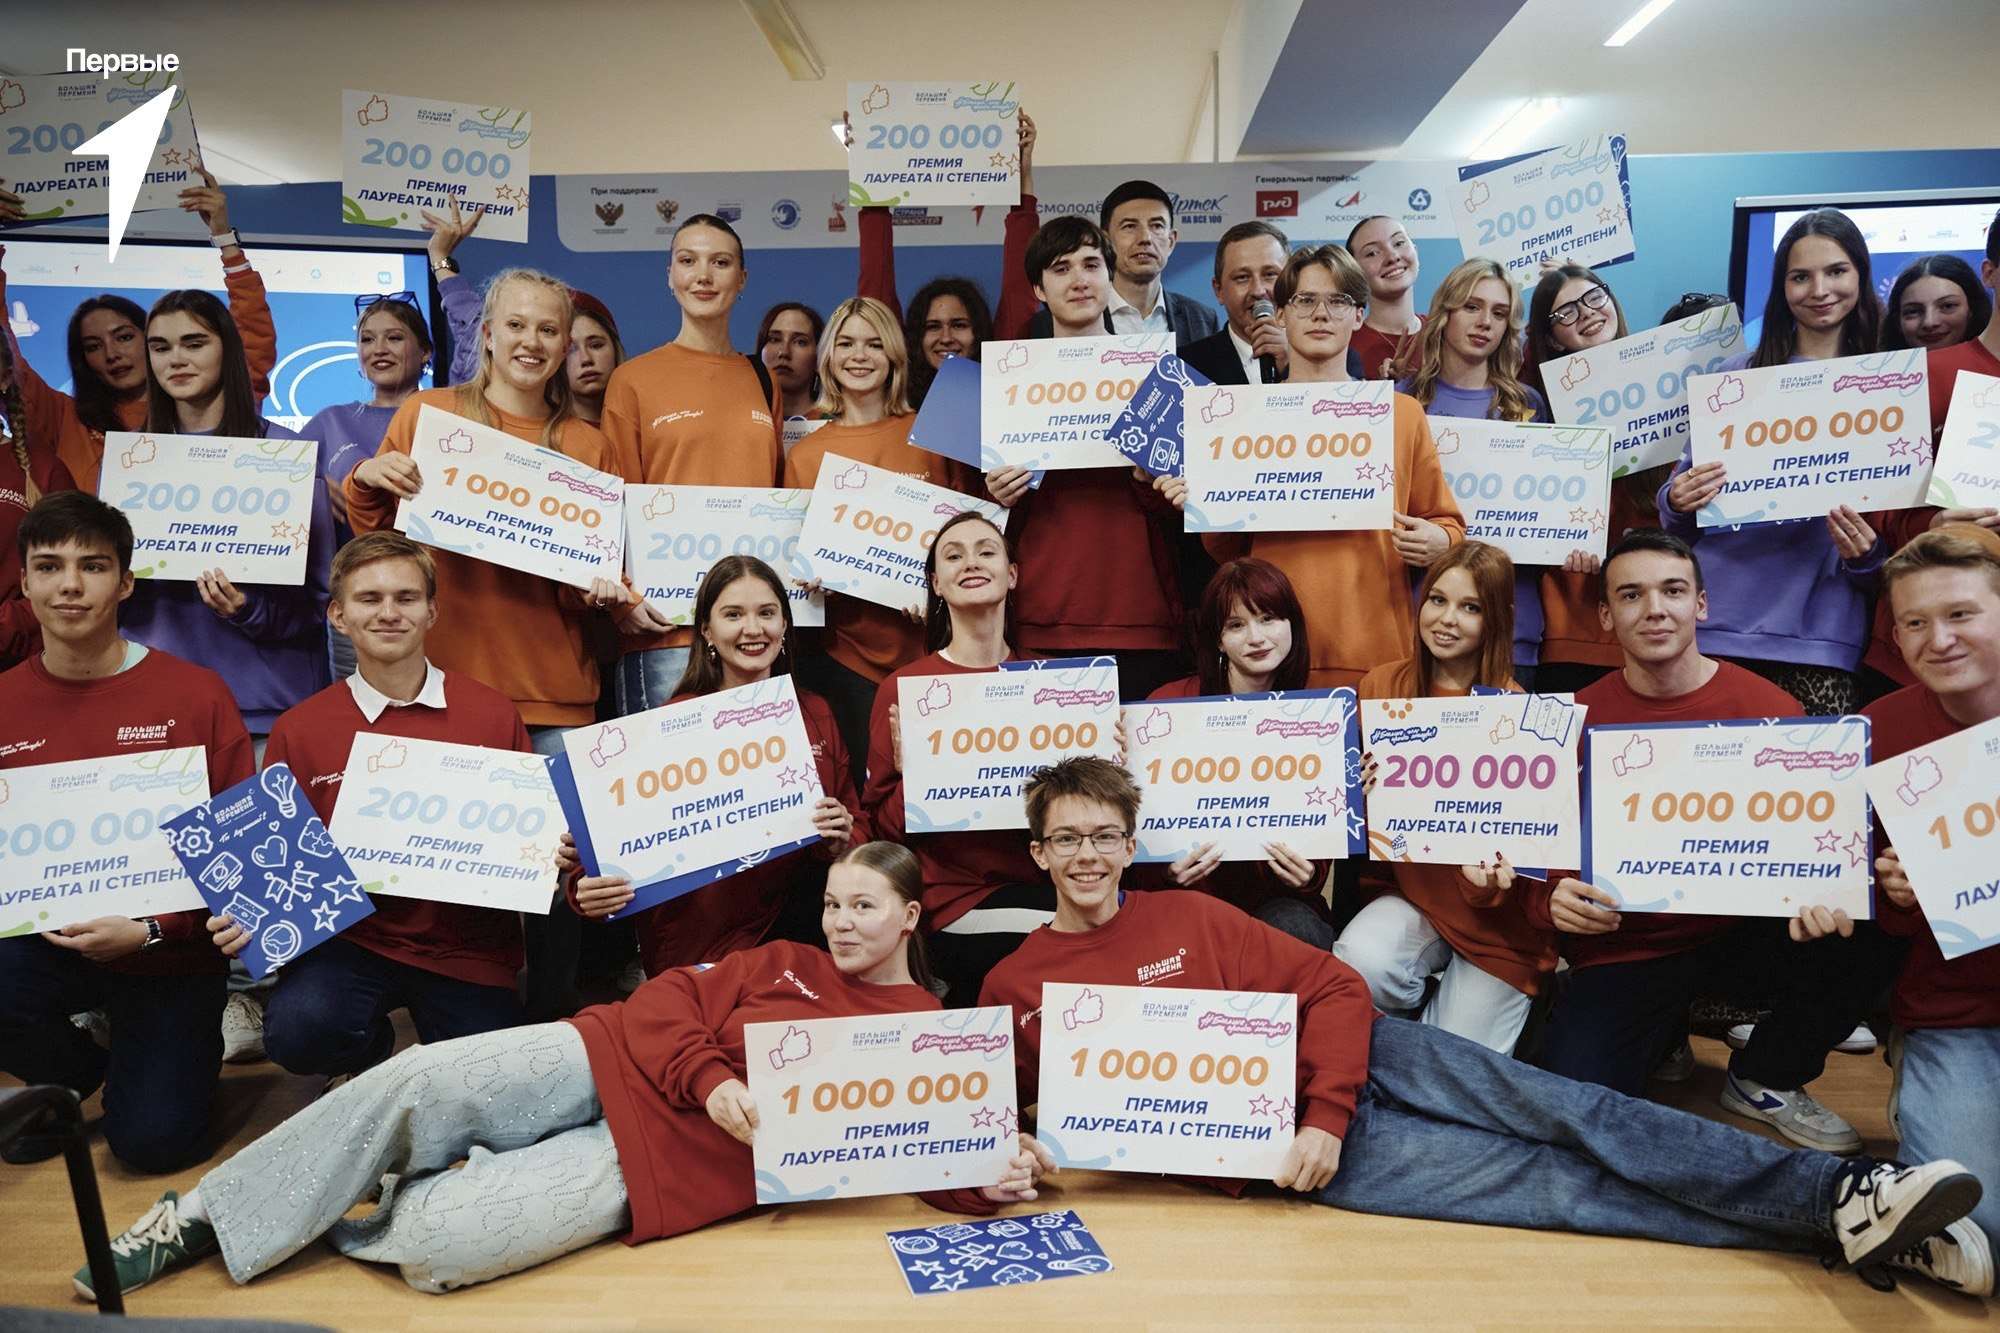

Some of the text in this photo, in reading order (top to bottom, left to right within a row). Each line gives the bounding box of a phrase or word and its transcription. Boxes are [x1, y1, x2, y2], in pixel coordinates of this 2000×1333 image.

[7, 123, 85, 155] 200
[866, 124, 1002, 150] 200 000
[65, 160, 109, 172] ПРЕМ
[361, 138, 511, 179] 200 000
[908, 158, 963, 168] ПРЕМИЯ
[14, 177, 97, 194] ЛАУРЕАТА
[406, 179, 467, 195] ПРЕМИЯ
[864, 172, 1007, 184] ЛАУРЕАТА II СТЕПЕНИ
[357, 189, 433, 208] ЛАУРЕАТА
[436, 199, 445, 208] II
[1182, 215, 1192, 224] НА
[1209, 215, 1221, 223] 100
[1477, 181, 1604, 246] 200 000
[1507, 225, 1617, 271] РЕАТА II СТЕПЕНИ
[1522, 225, 1573, 251] ПРЕМИЯ
[1005, 385, 1017, 405] 1
[1027, 381, 1086, 405] 000
[1576, 382, 1645, 424] 200
[1048, 414, 1111, 426] ПРЕМИЯ
[1628, 405, 1689, 432] ПРЕМИЯ
[1718, 407, 1904, 449] 1 000 000
[1000, 431, 1077, 444] ЛАУРЕАТА
[1209, 432, 1372, 460] 1 000 000
[1614, 427, 1671, 452] РЕАТА II
[1773, 452, 1849, 470] ПРЕМИЯ
[1255, 472, 1322, 484] ПРЕМИЯ
[1816, 473, 1820, 484] I
[1826, 464, 1911, 484] СТЕПЕНИ
[121, 481, 290, 516] 200 000
[443, 467, 459, 486] 1
[466, 474, 530, 507] 000
[539, 496, 601, 529] 000
[1204, 488, 1375, 502] ЛАУРЕАТА I СТЕПЕНИ
[1514, 474, 1586, 501] 000
[486, 511, 553, 537] ПРЕМИЯ
[832, 504, 913, 542] 1 000
[1475, 510, 1538, 521] ПРЕМИЯ
[169, 523, 238, 536] ПРЕМИЯ
[431, 510, 601, 565] ЛАУРЕАТА I СТЕПЕНИ
[1465, 526, 1588, 540] ЕАТА II СТЕПЕНИ
[134, 539, 290, 556] УРЕАТА II СТЕПЕНИ
[648, 532, 721, 561] 200
[816, 548, 891, 578] ЛАУРЕАТА
[117, 732, 167, 740] ПЕРЕМЕНА
[118, 725, 167, 734] БОЛЬШАЯ
[928, 722, 1098, 755] 1 000 000
[609, 736, 786, 806] 1 000 000
[1145, 754, 1321, 784] 1 000 000
[1383, 755, 1556, 789] 200 000
[672, 789, 744, 820] ПРЕМИЯ
[925, 785, 1012, 800] ЛАУРЕАТА
[1197, 797, 1269, 810] ПРЕМИЯ
[358, 787, 545, 837] 200 000
[1435, 801, 1502, 814] ПРЕМИЯ
[1622, 791, 1835, 822] 1 000 000
[620, 792, 803, 856] ЛАУРЕАТА I СТЕПЕНИ
[1142, 815, 1326, 830] ЛАУРЕАТА I СТЕПЕНИ
[1386, 819, 1558, 836] ЛАУРЕАТА I СТЕПЕНИ
[1929, 815, 1951, 849] 1
[407, 835, 483, 855] ПРЕМИЯ
[1682, 840, 1769, 854] ПРЕМИЯ
[44, 856, 129, 880] ПРЕМИЯ
[343, 847, 539, 881] ЛАУРЕАТА II СТЕПЕНИ
[1617, 861, 1842, 878] ЛАУРЕАТА I СТЕПЕНИ
[89, 881, 100, 893] II
[1137, 955, 1181, 975] БОЛЬШАЯ
[1138, 962, 1182, 981] ПЕРЕМЕНА
[1071, 1048, 1269, 1086] 1 000 000
[782, 1072, 989, 1114] 1 000 000
[1125, 1098, 1208, 1114] ПРЕМИЯ
[845, 1122, 930, 1140] ПРЕМИЯ
[1061, 1116, 1272, 1140] ЛАУРЕАТА I СТЕПЕНИ
[780, 1136, 996, 1166] ЛАУРЕАТА I СТЕПЕНИ
